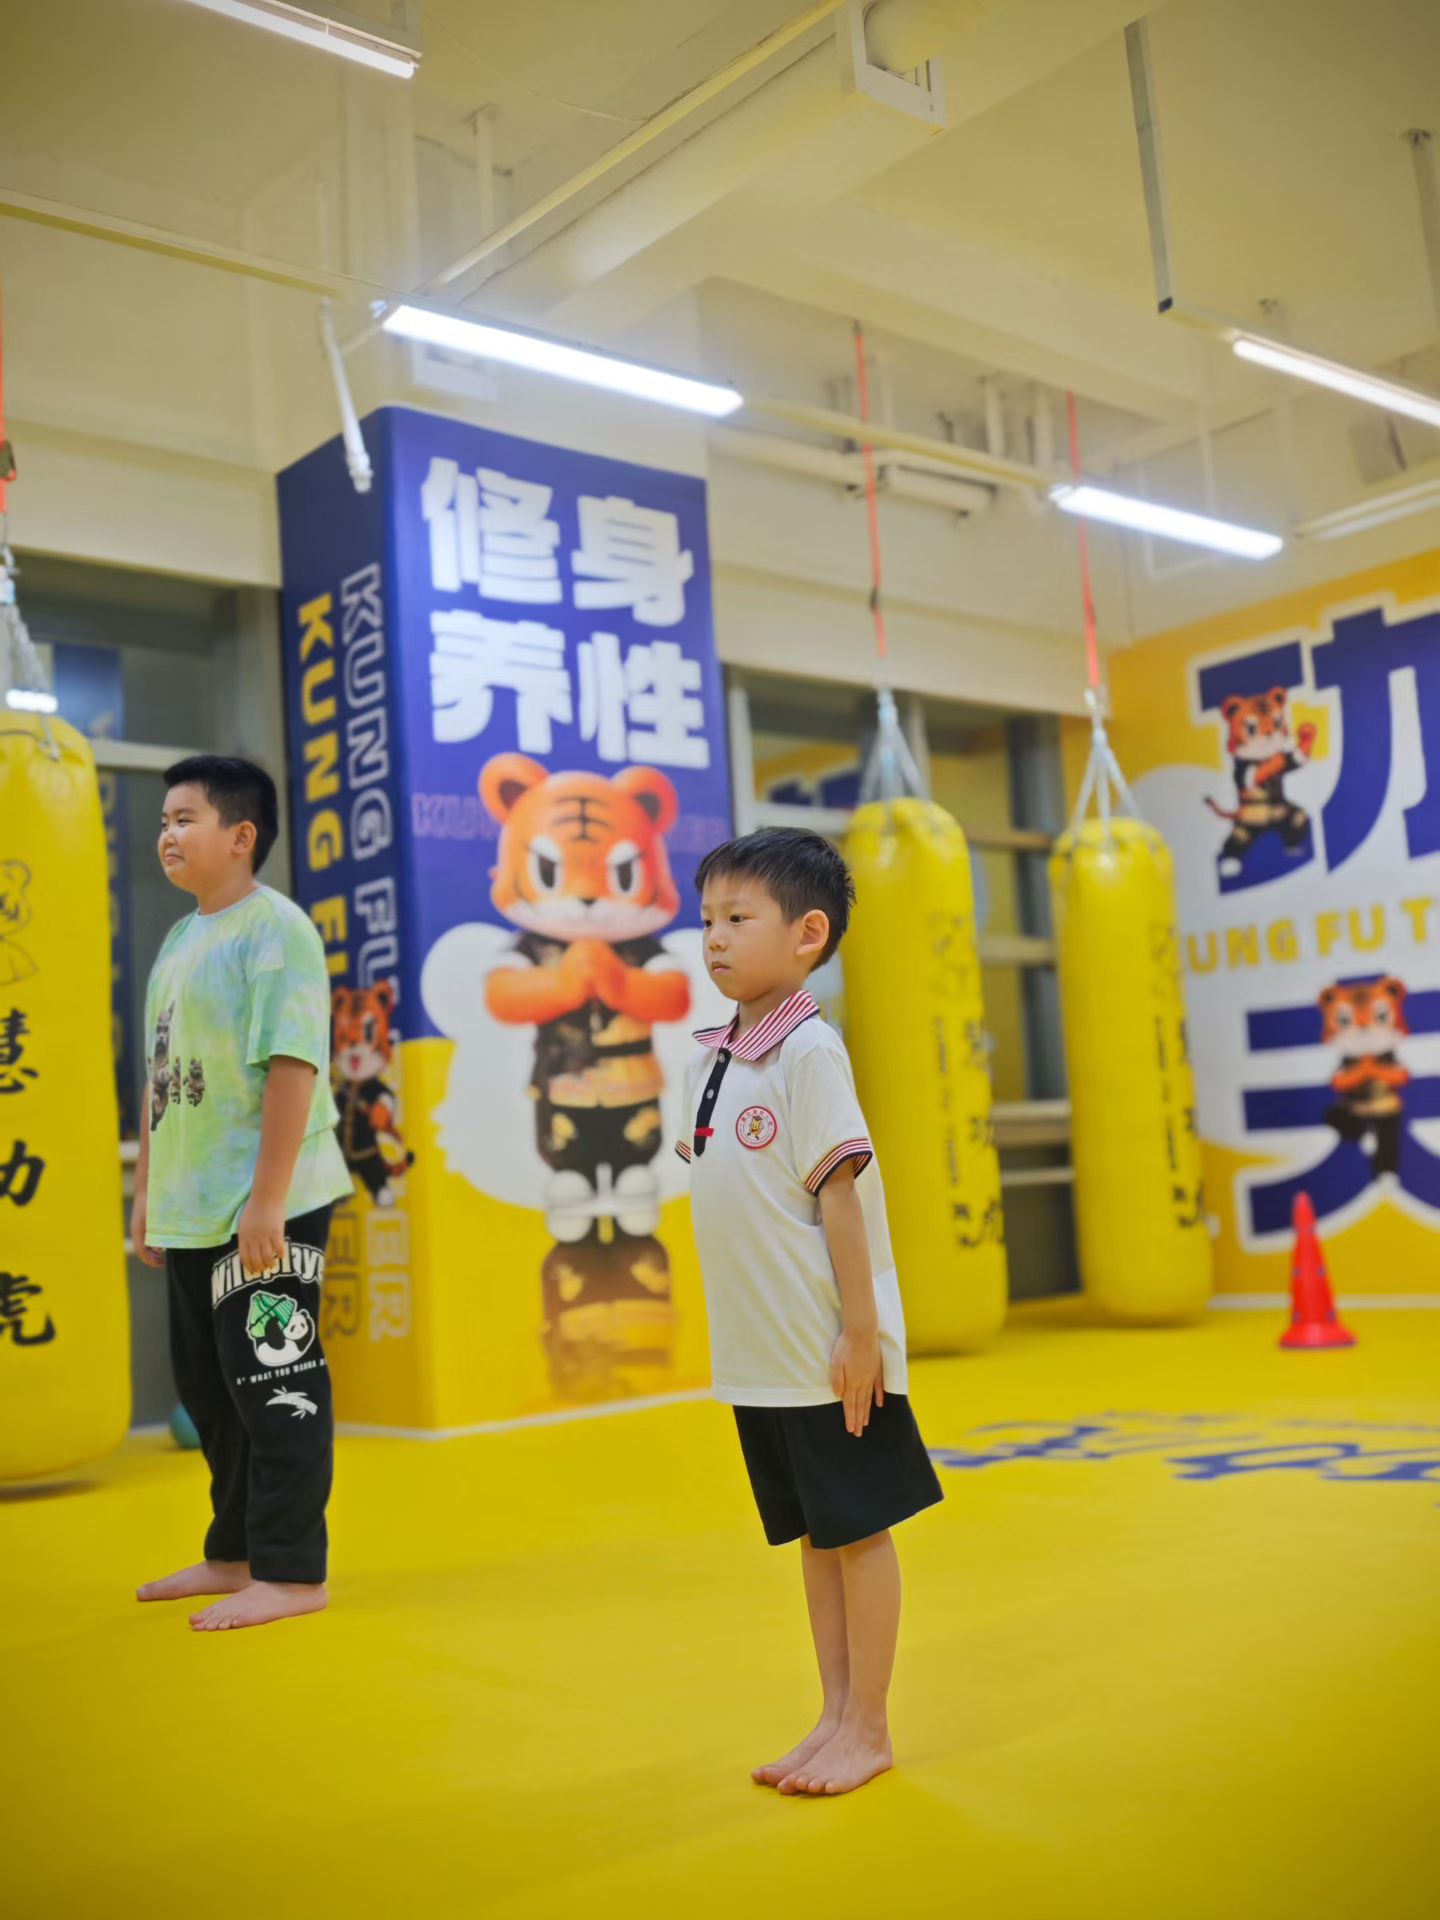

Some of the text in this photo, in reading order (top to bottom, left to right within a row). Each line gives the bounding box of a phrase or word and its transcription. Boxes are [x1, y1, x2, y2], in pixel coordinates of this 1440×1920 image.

[421, 457, 694, 627] 修身
[298, 592, 344, 872] KUNG
[341, 562, 392, 861] KUNG
[430, 608, 709, 770] 养性
[1187, 916, 1299, 976] UNG
[1315, 904, 1387, 955] FU
